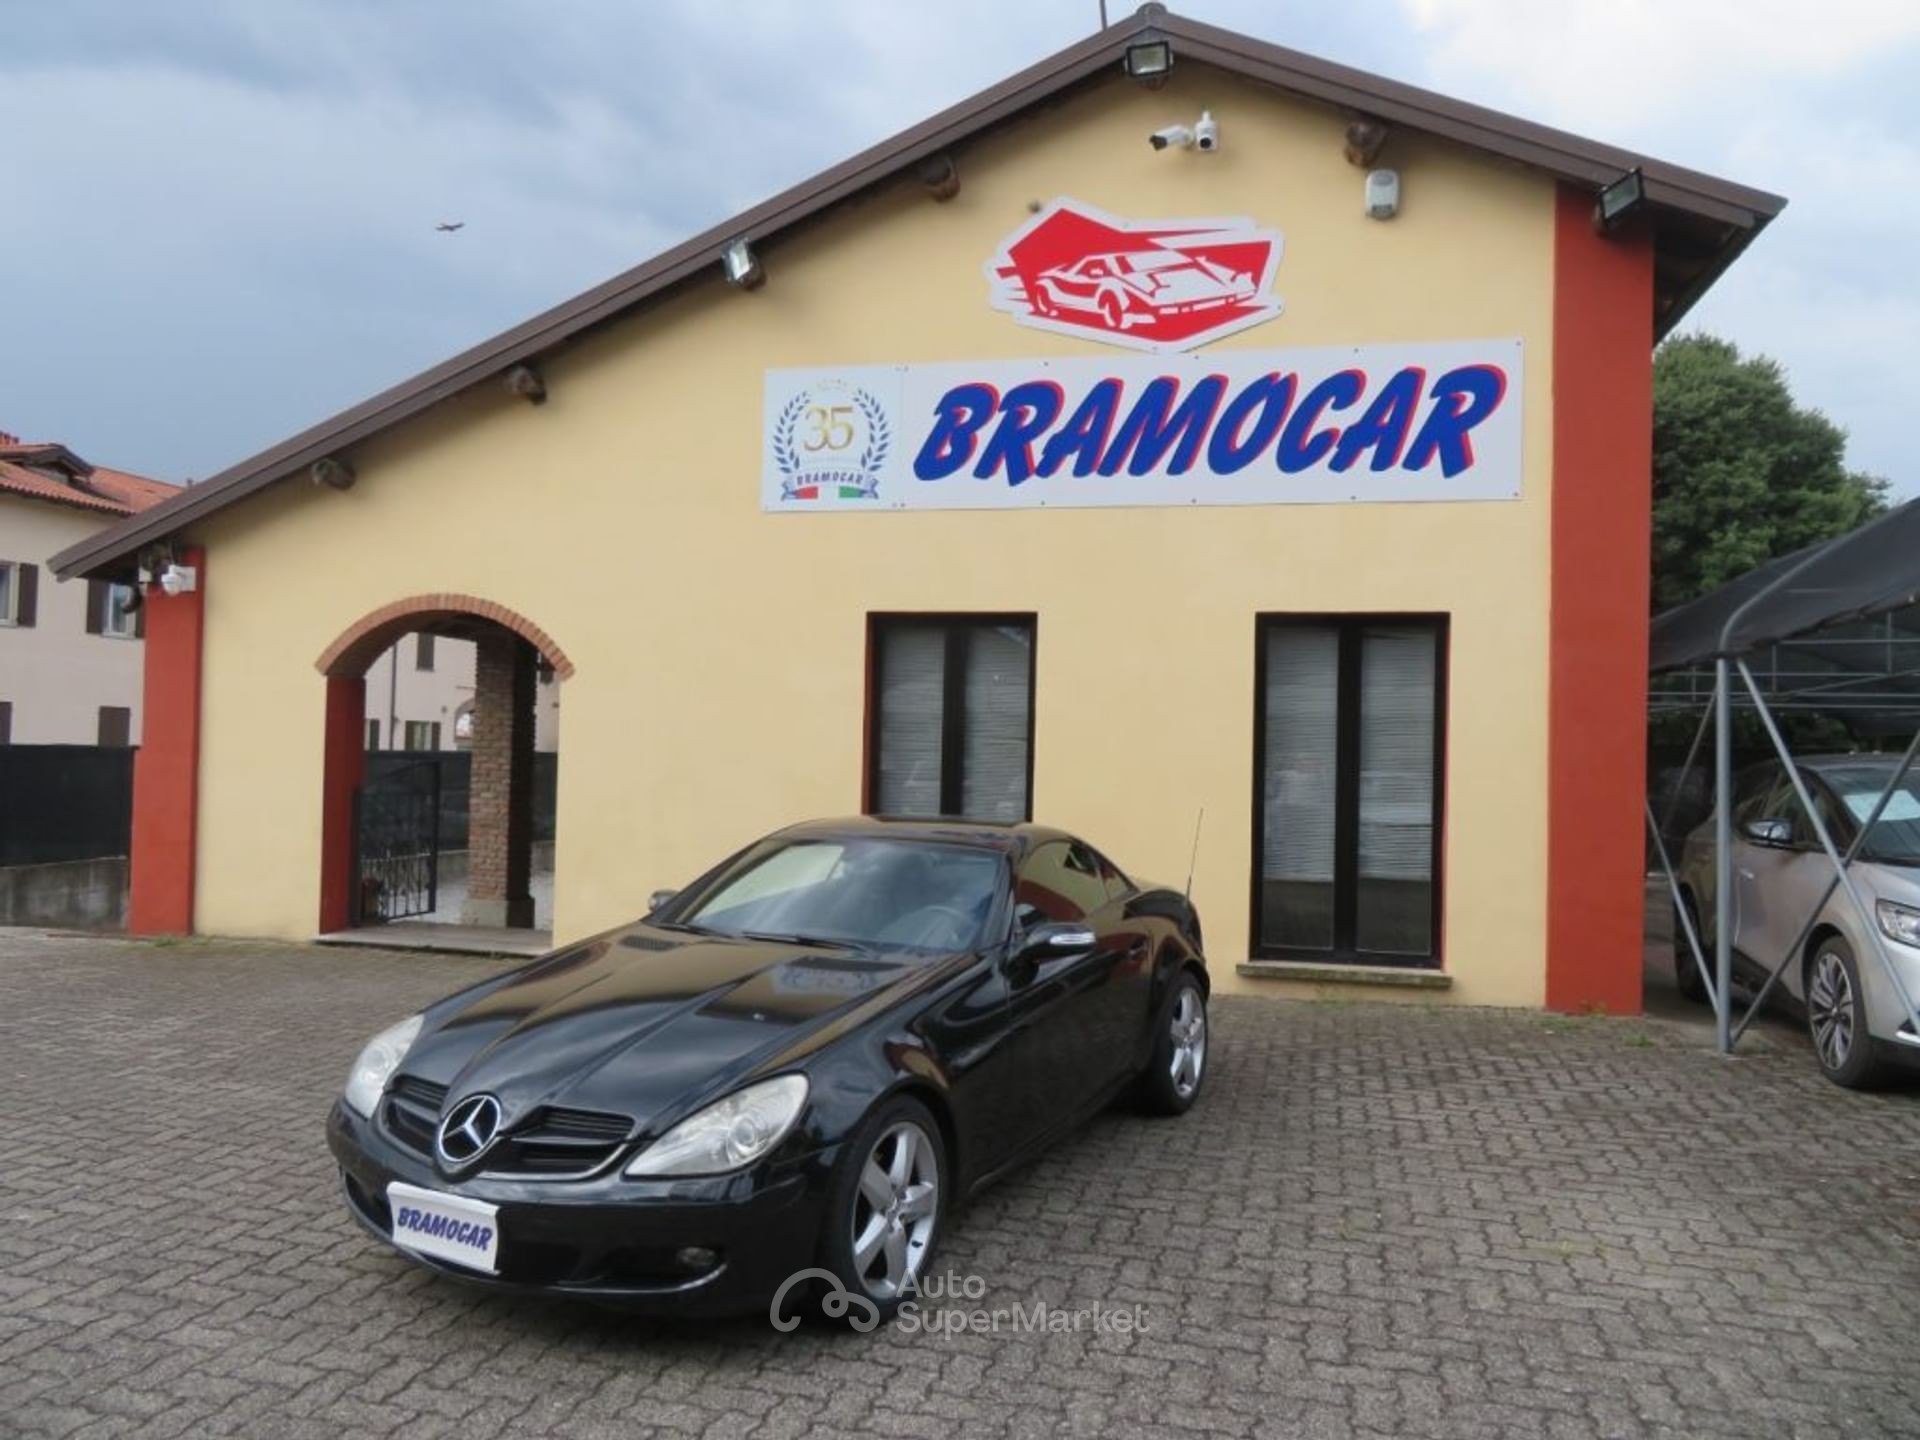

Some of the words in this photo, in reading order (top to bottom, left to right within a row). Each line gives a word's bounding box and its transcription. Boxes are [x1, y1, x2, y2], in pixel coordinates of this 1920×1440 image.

[804, 405, 854, 451] 35
[913, 364, 1507, 487] BRAMOCAR
[796, 471, 863, 486] BRAMOCAR
[398, 1206, 493, 1251] BRAMOCAR
